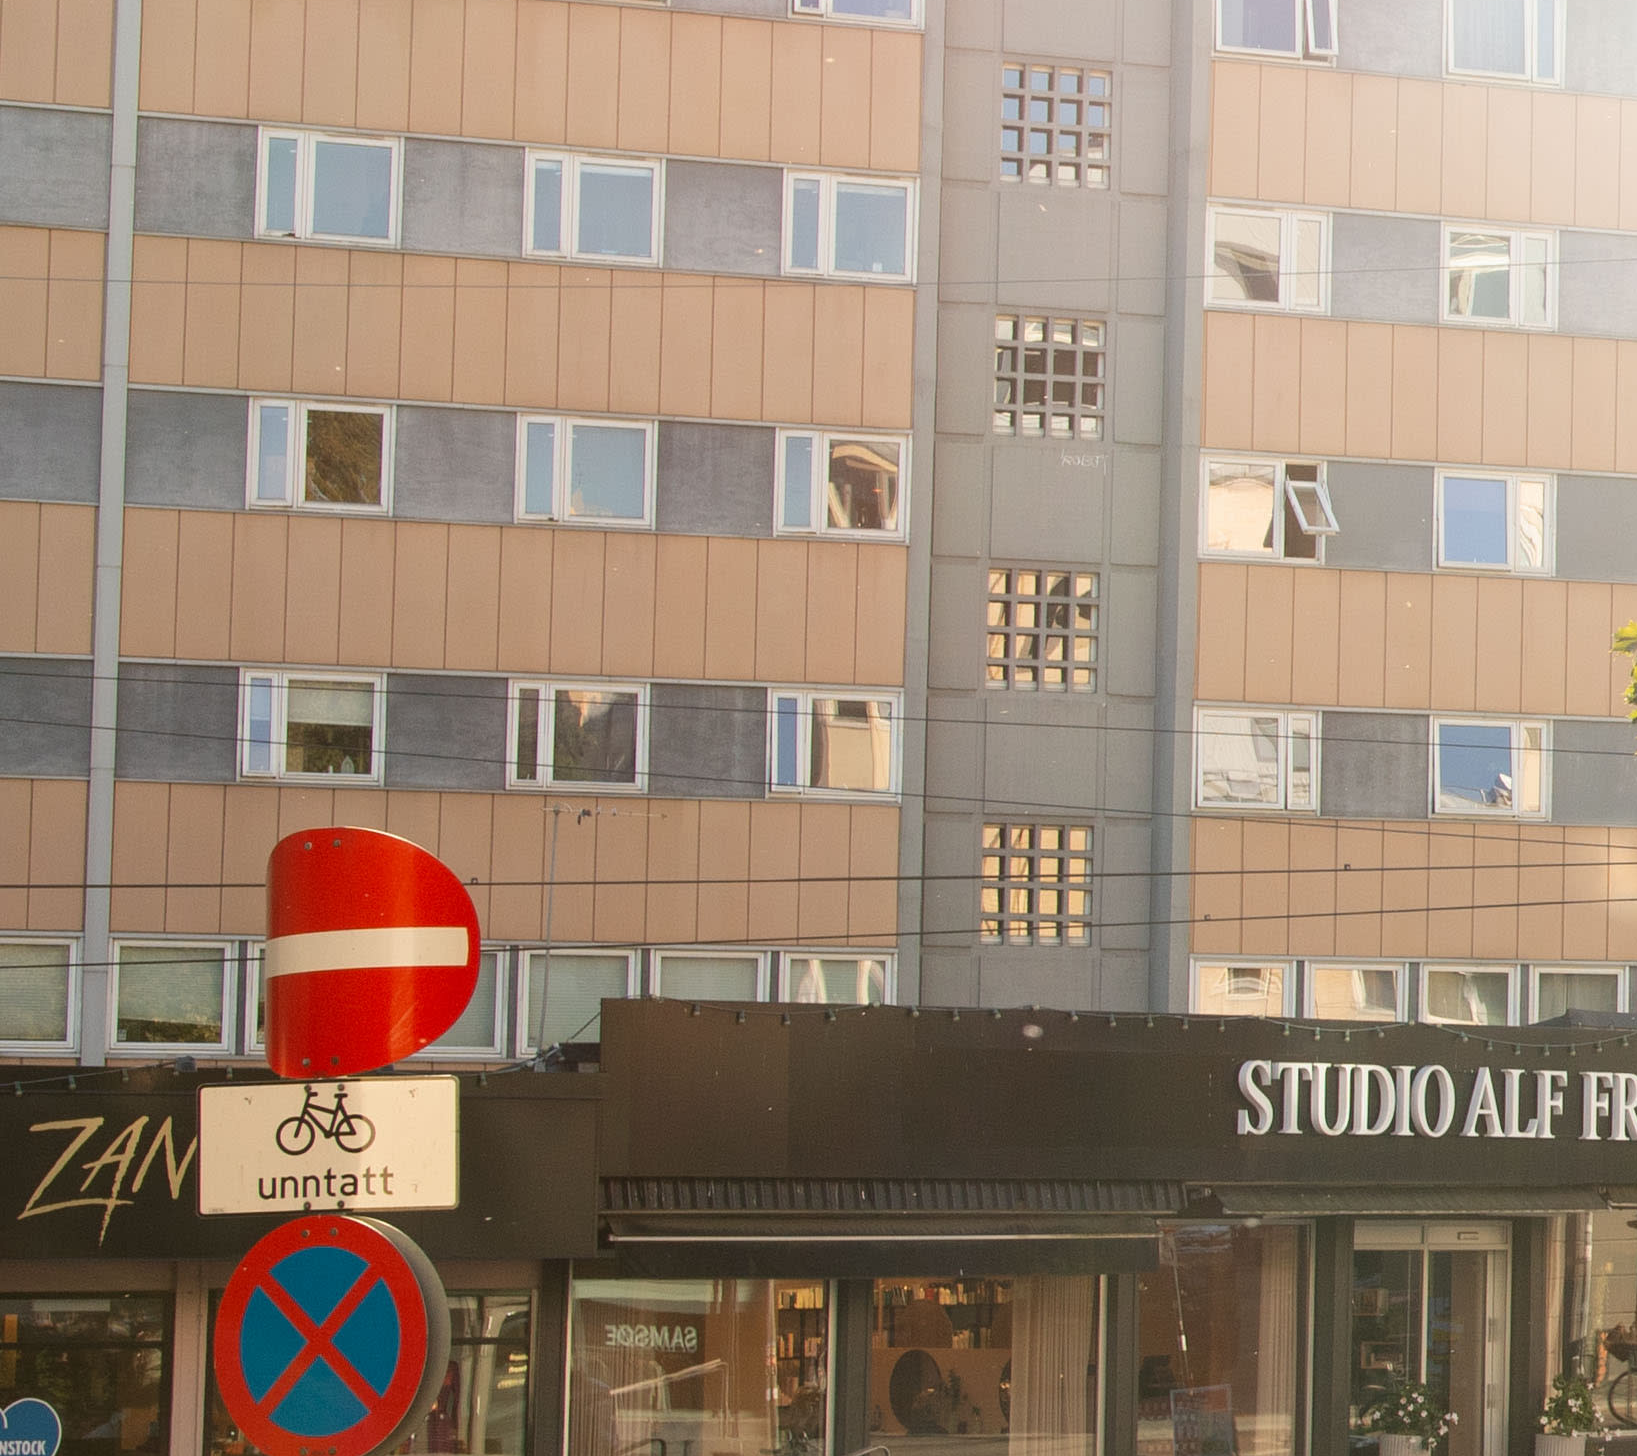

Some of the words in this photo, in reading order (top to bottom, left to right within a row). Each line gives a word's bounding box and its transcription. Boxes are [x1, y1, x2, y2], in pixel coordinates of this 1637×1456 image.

[1237, 1059, 1456, 1138] STUDIO
[1461, 1067, 1567, 1140] ALF
[258, 1164, 394, 1202] unntatt
